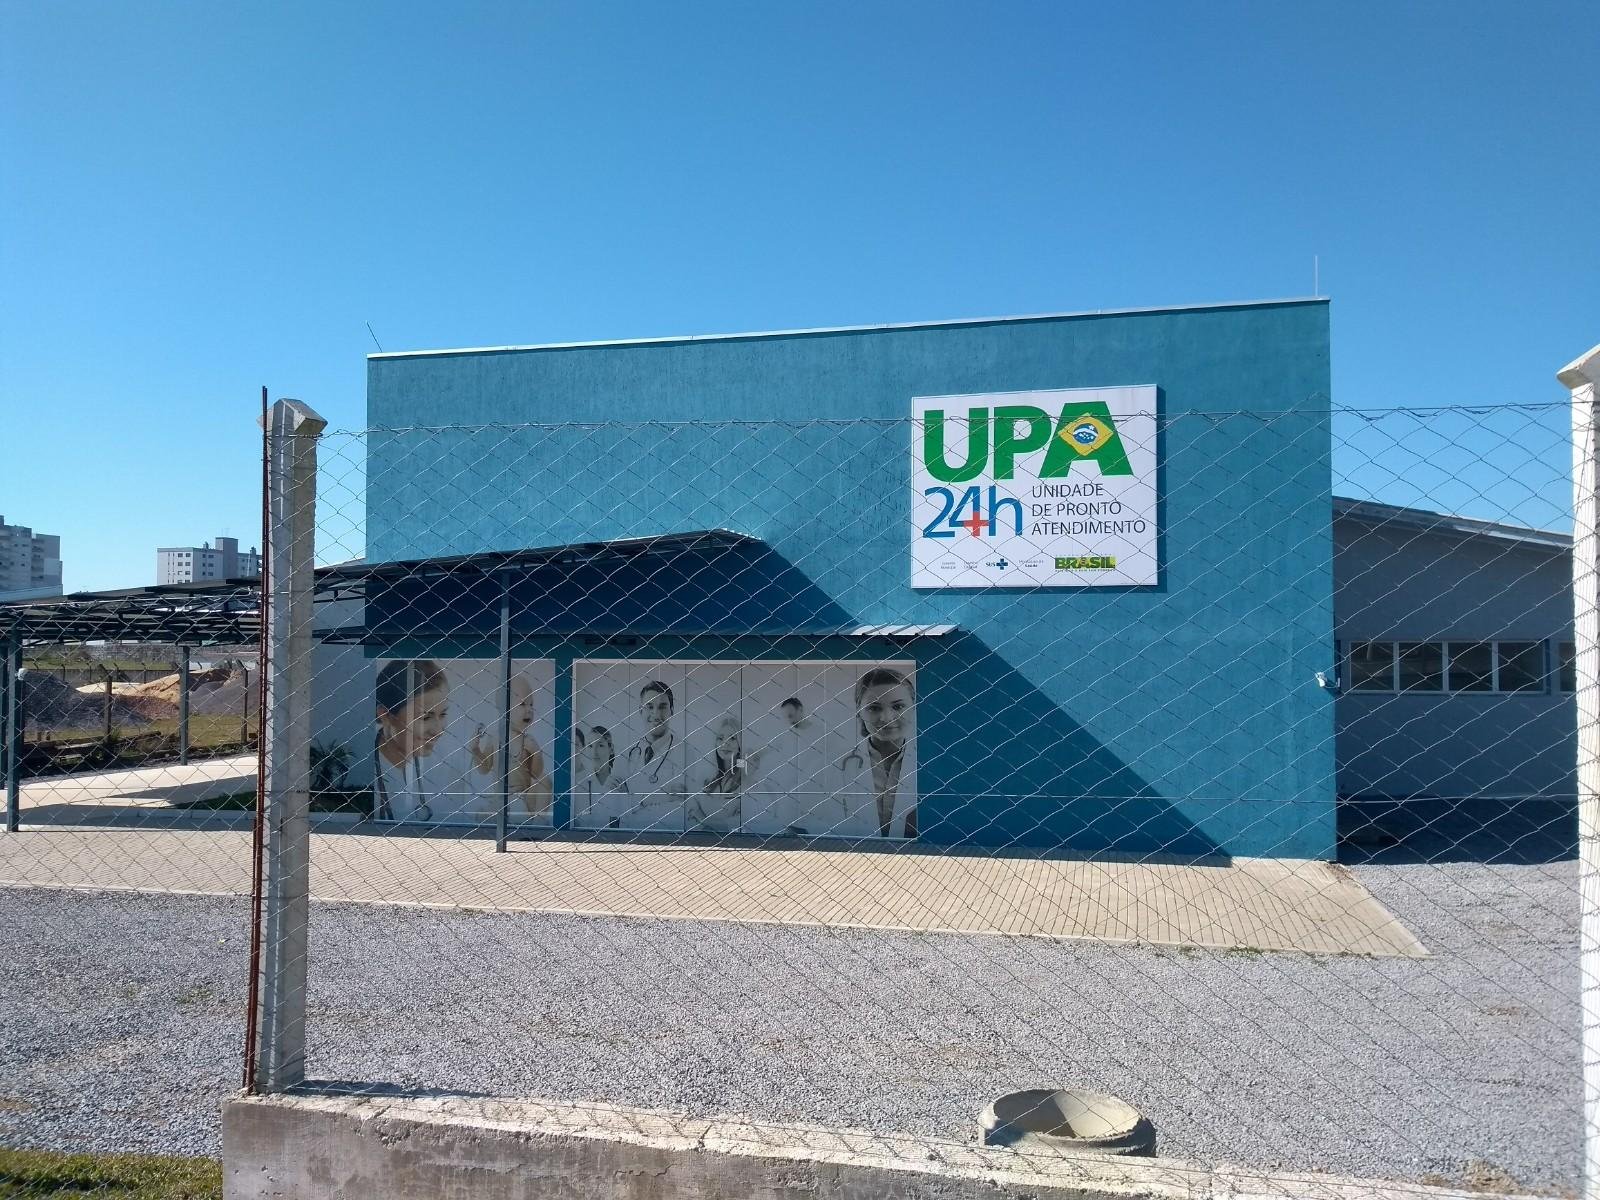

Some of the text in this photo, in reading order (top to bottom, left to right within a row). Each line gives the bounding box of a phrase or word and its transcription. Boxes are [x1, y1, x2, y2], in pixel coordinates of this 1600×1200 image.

[924, 401, 1134, 482] UPA
[1032, 483, 1103, 498] UNIDADE
[923, 485, 1023, 538] 24h
[1032, 501, 1122, 517] DE PRONTO
[1032, 519, 1146, 536] ATENDIMENTO
[1055, 557, 1116, 569] BRASIL
